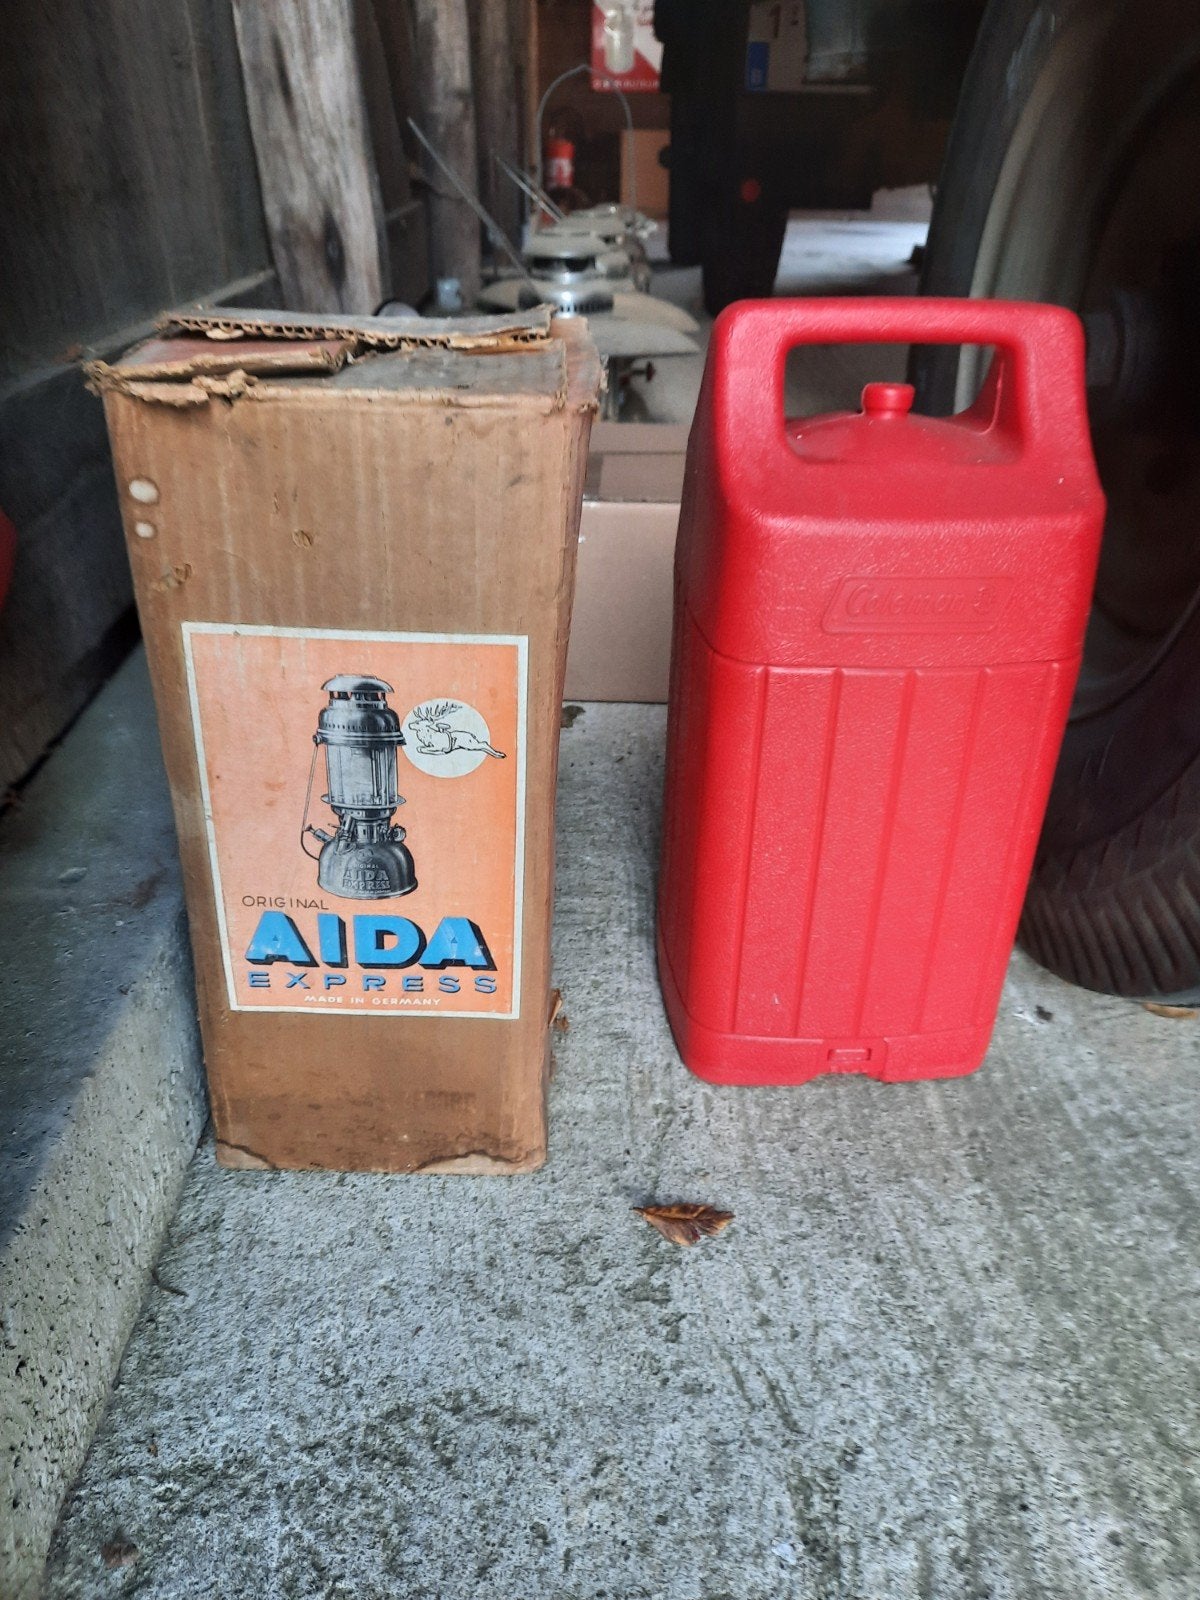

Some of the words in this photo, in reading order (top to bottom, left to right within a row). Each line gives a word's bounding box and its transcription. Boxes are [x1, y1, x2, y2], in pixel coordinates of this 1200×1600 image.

[242, 895, 329, 910] ORIGINAL
[245, 911, 498, 971] AIDA
[247, 971, 498, 993] EXPRESS
[304, 995, 343, 1004] MADE
[350, 996, 365, 1004] IN
[372, 997, 441, 1006] GERMANY
